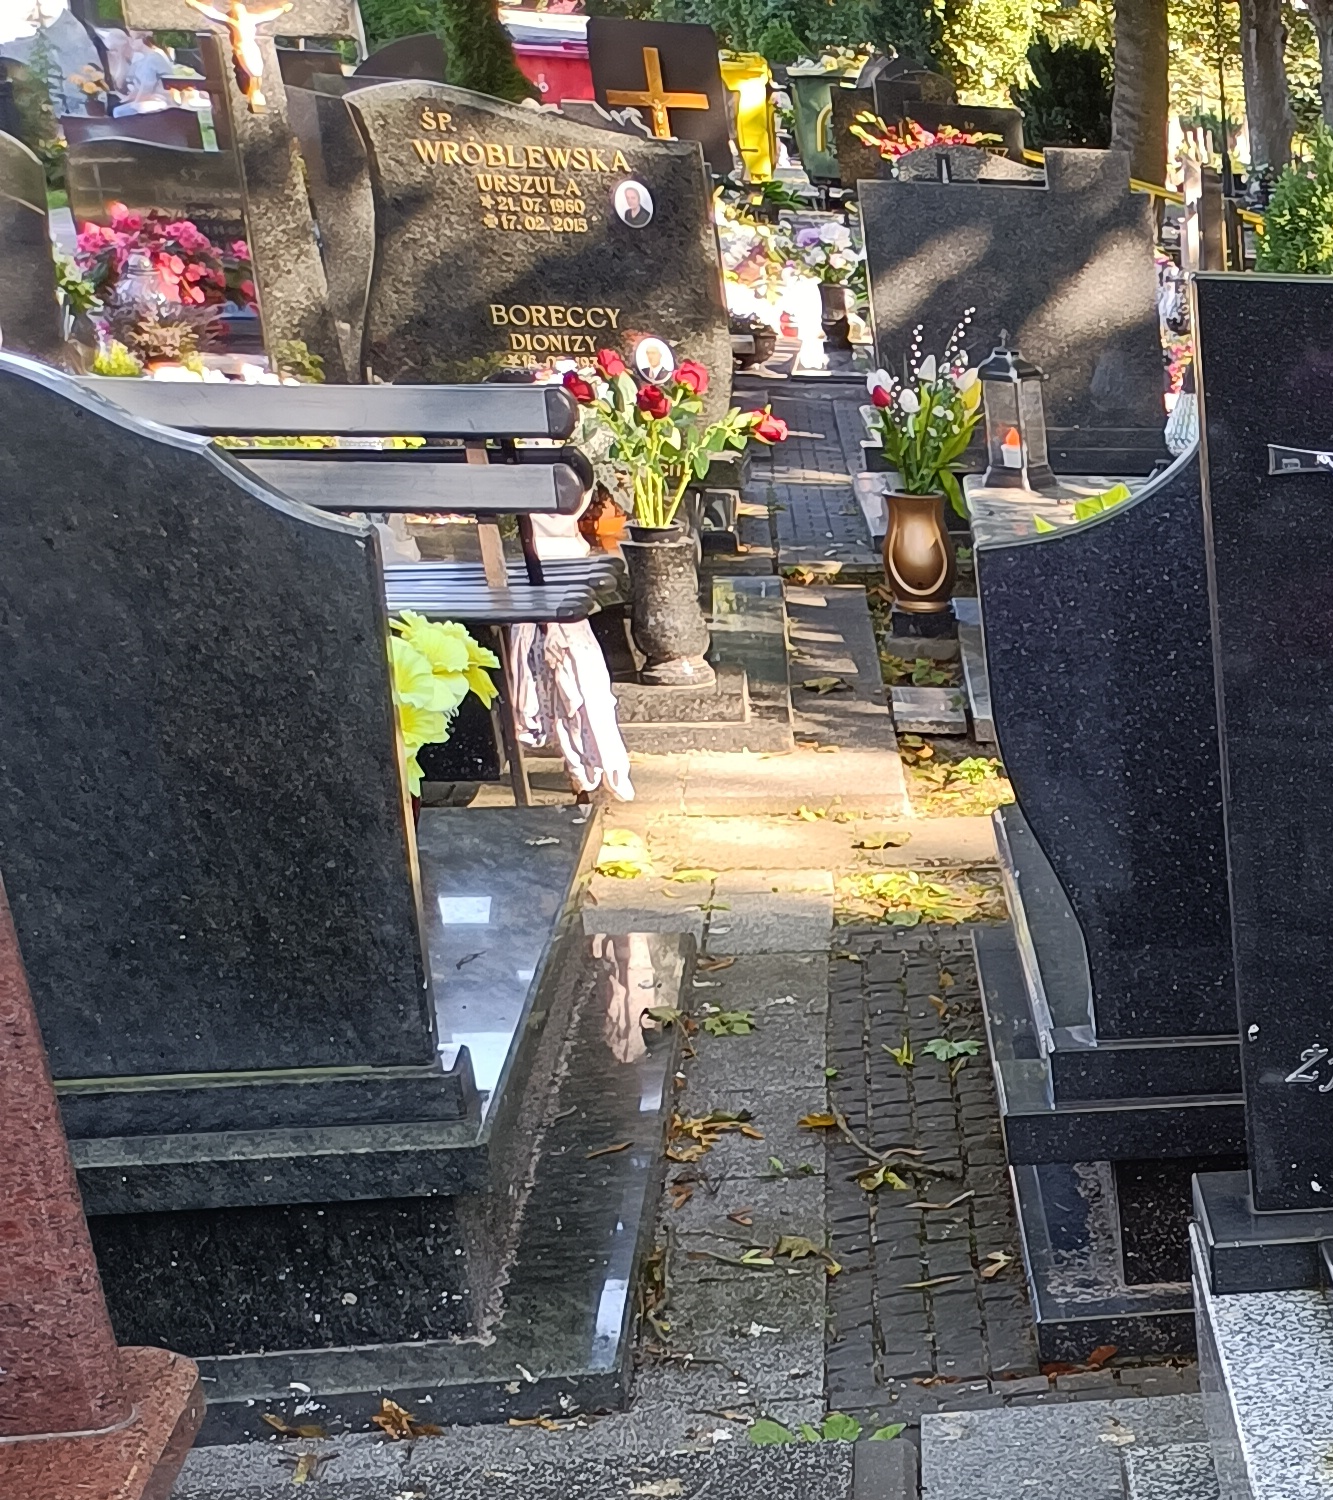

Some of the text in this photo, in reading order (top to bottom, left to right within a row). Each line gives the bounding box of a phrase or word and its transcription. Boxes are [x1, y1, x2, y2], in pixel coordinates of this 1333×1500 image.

[412, 136, 633, 173] WRÓBLEWSKA
[476, 173, 582, 196] URSZULA
[489, 303, 621, 329] BORECCY
[509, 333, 598, 353] DIONIZY
